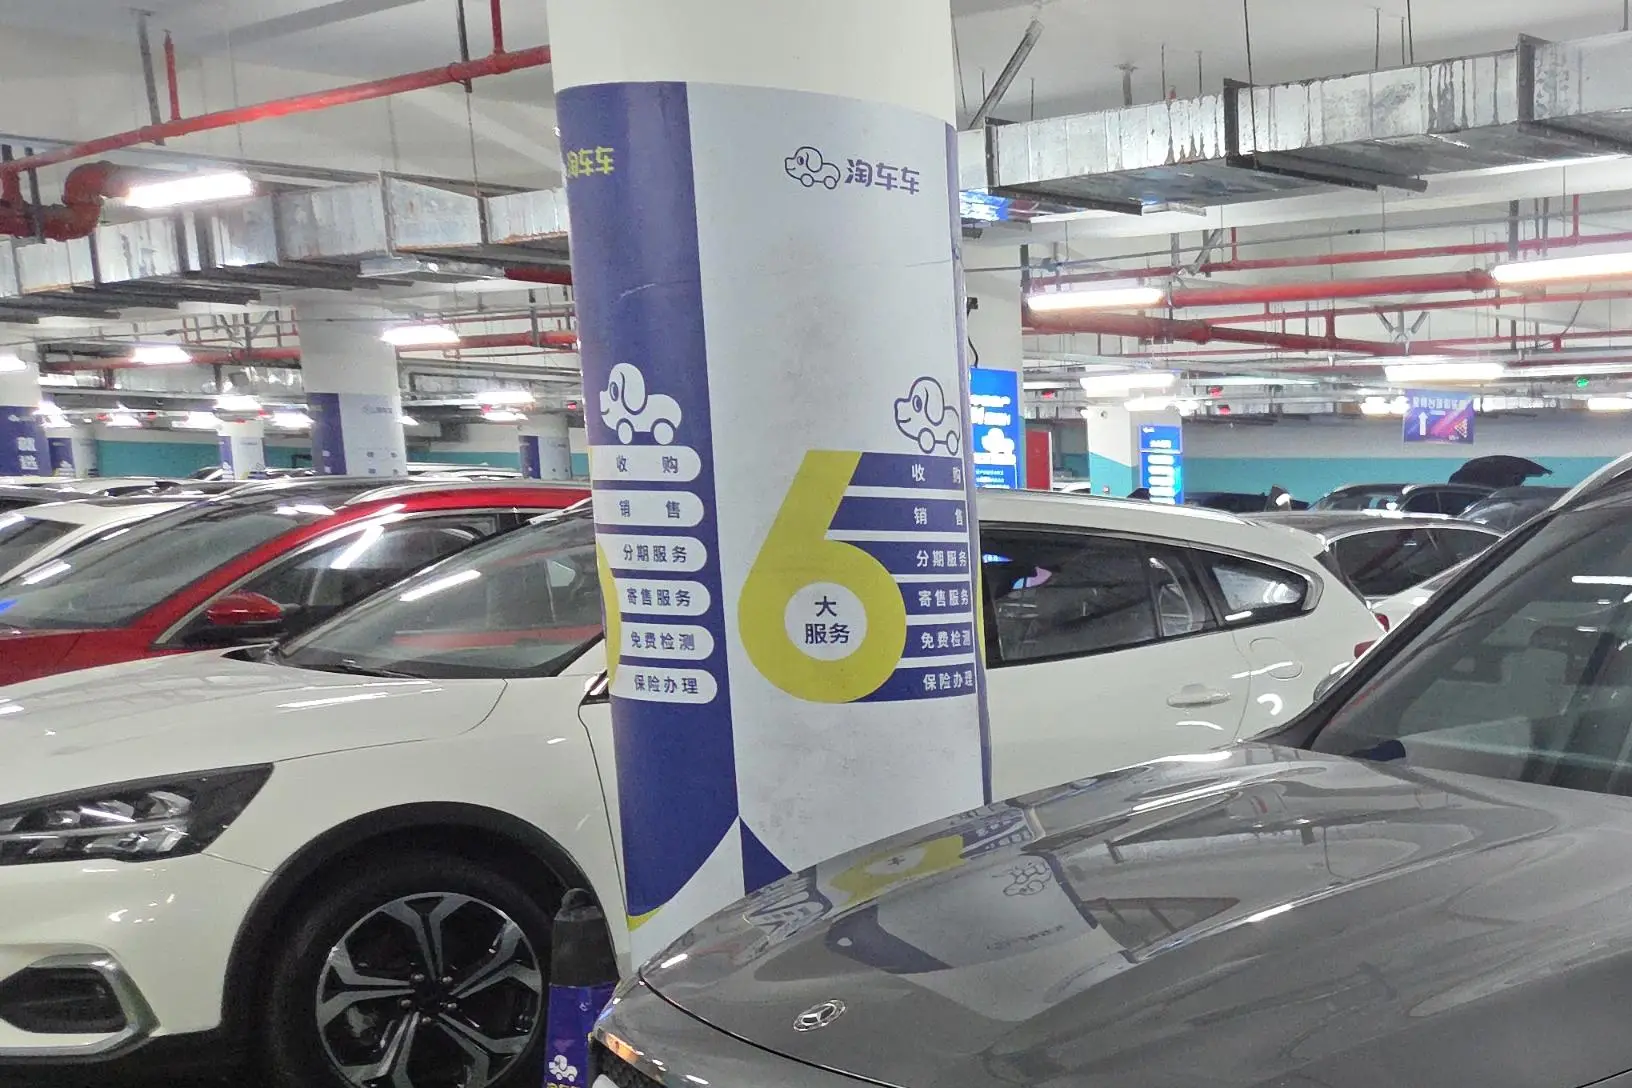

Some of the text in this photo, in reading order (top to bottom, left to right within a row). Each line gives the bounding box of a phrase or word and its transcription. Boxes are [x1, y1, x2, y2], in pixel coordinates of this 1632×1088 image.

[844, 158, 920, 195] 淘车车
[616, 455, 679, 474] 收购
[911, 464, 961, 484] 收购
[619, 500, 681, 519] 销售
[914, 507, 963, 526] 销售
[623, 544, 687, 563] 分期服务
[916, 550, 967, 568] 分期服务
[626, 587, 691, 607] 寄售服务
[814, 596, 837, 617] 大
[918, 589, 969, 607] 寄售服务
[631, 631, 695, 651] 免费检测
[805, 623, 850, 645] 服务
[921, 630, 971, 649] 免费检测
[634, 674, 698, 694] 保险办理
[923, 670, 973, 691] 保险办理
